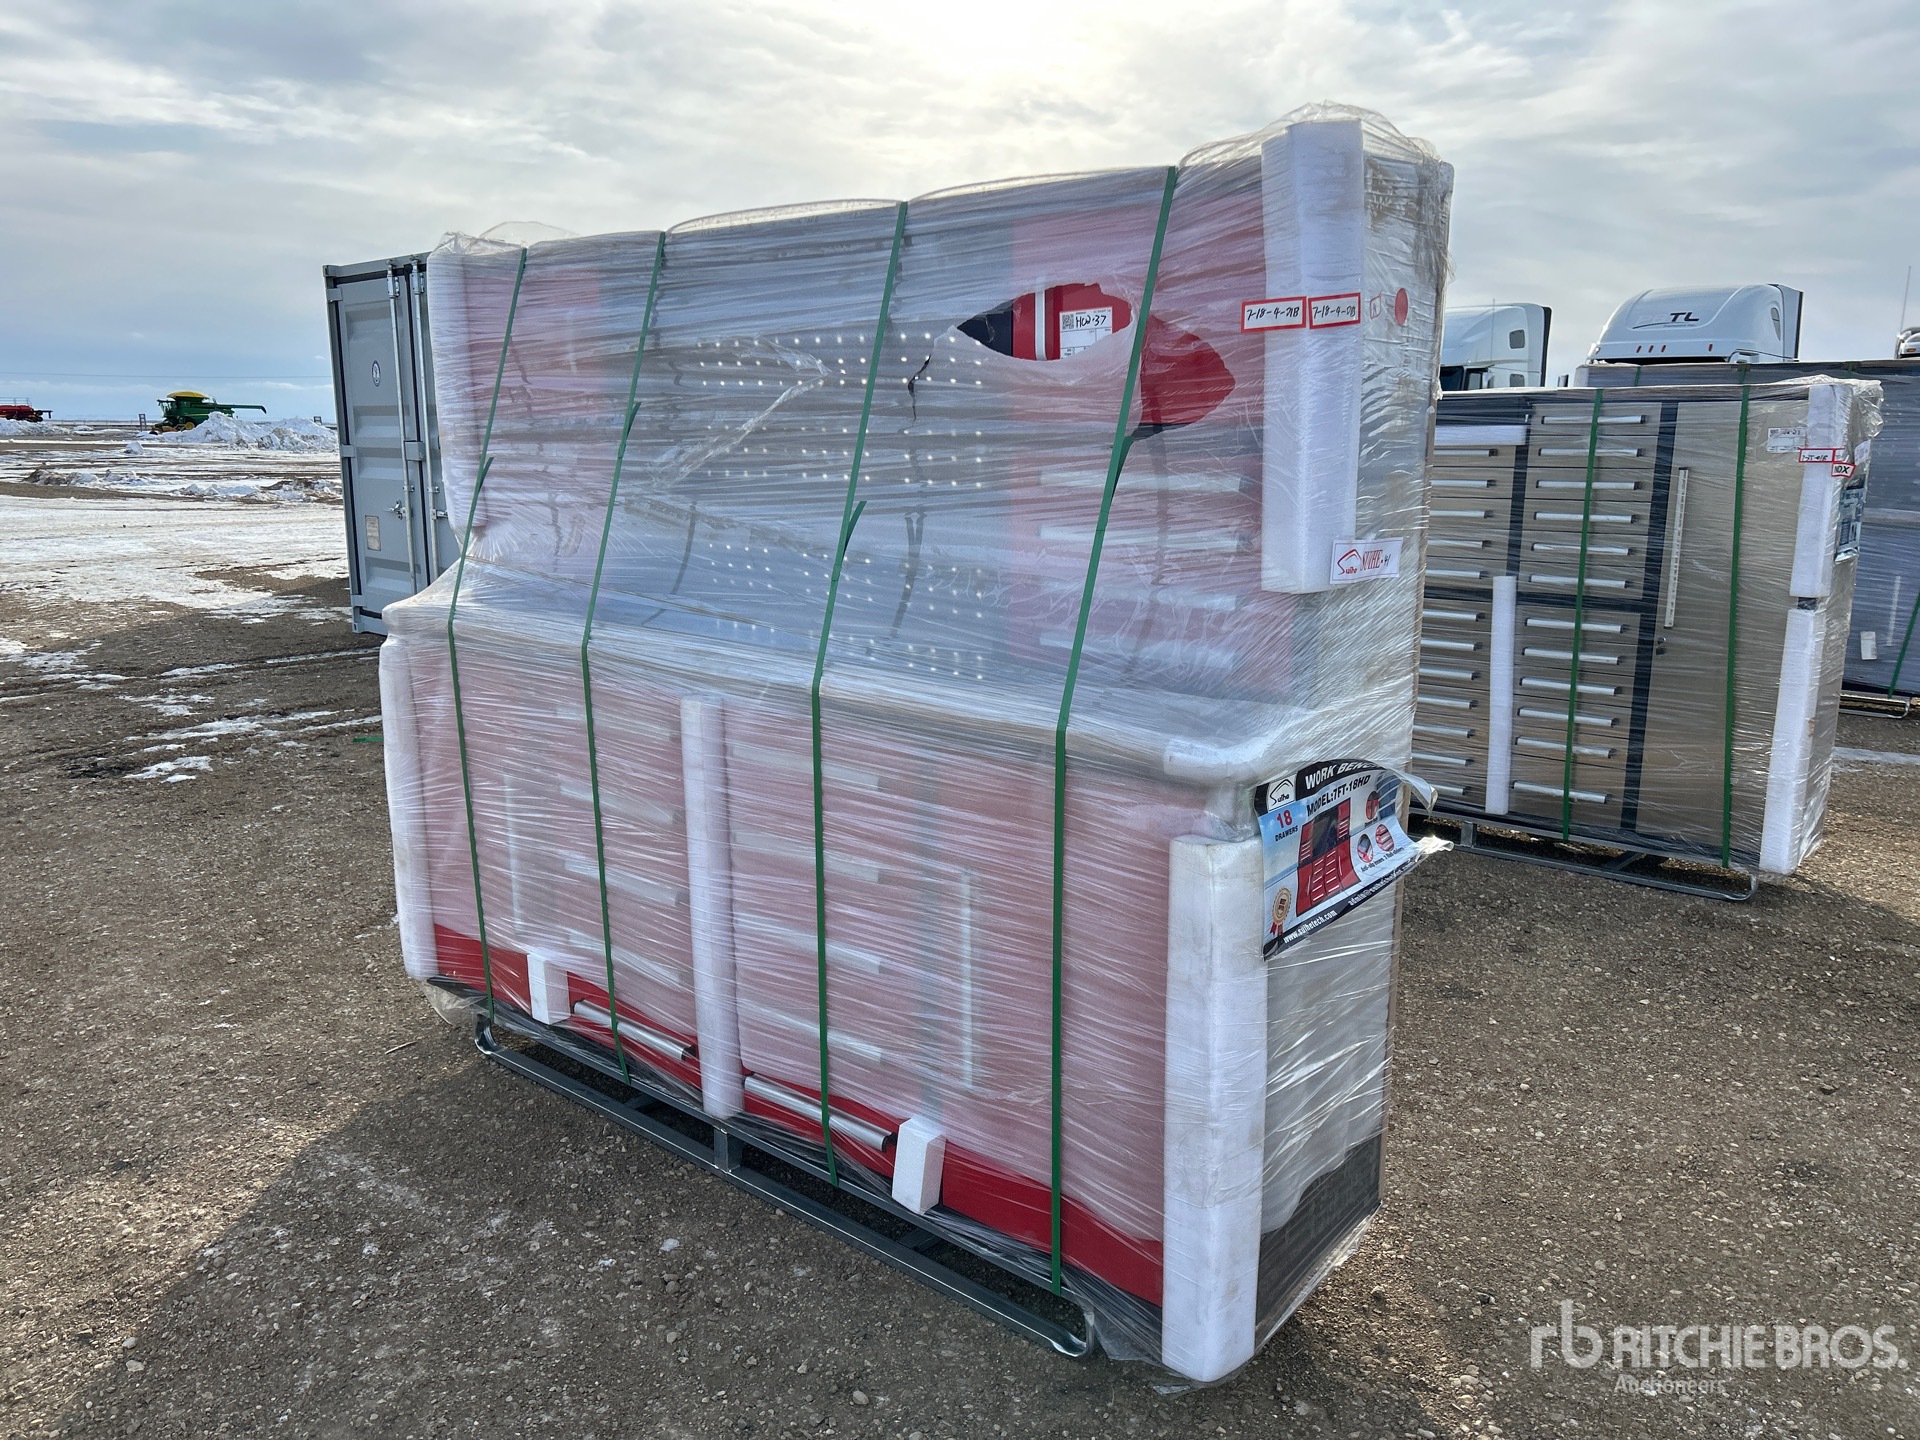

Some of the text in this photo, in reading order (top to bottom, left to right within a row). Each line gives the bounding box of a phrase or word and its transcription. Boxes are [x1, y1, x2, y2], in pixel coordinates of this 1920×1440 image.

[1305, 764, 1337, 790] WORK
[1276, 809, 1293, 829] 18
[1275, 825, 1298, 842] DRAWERS
